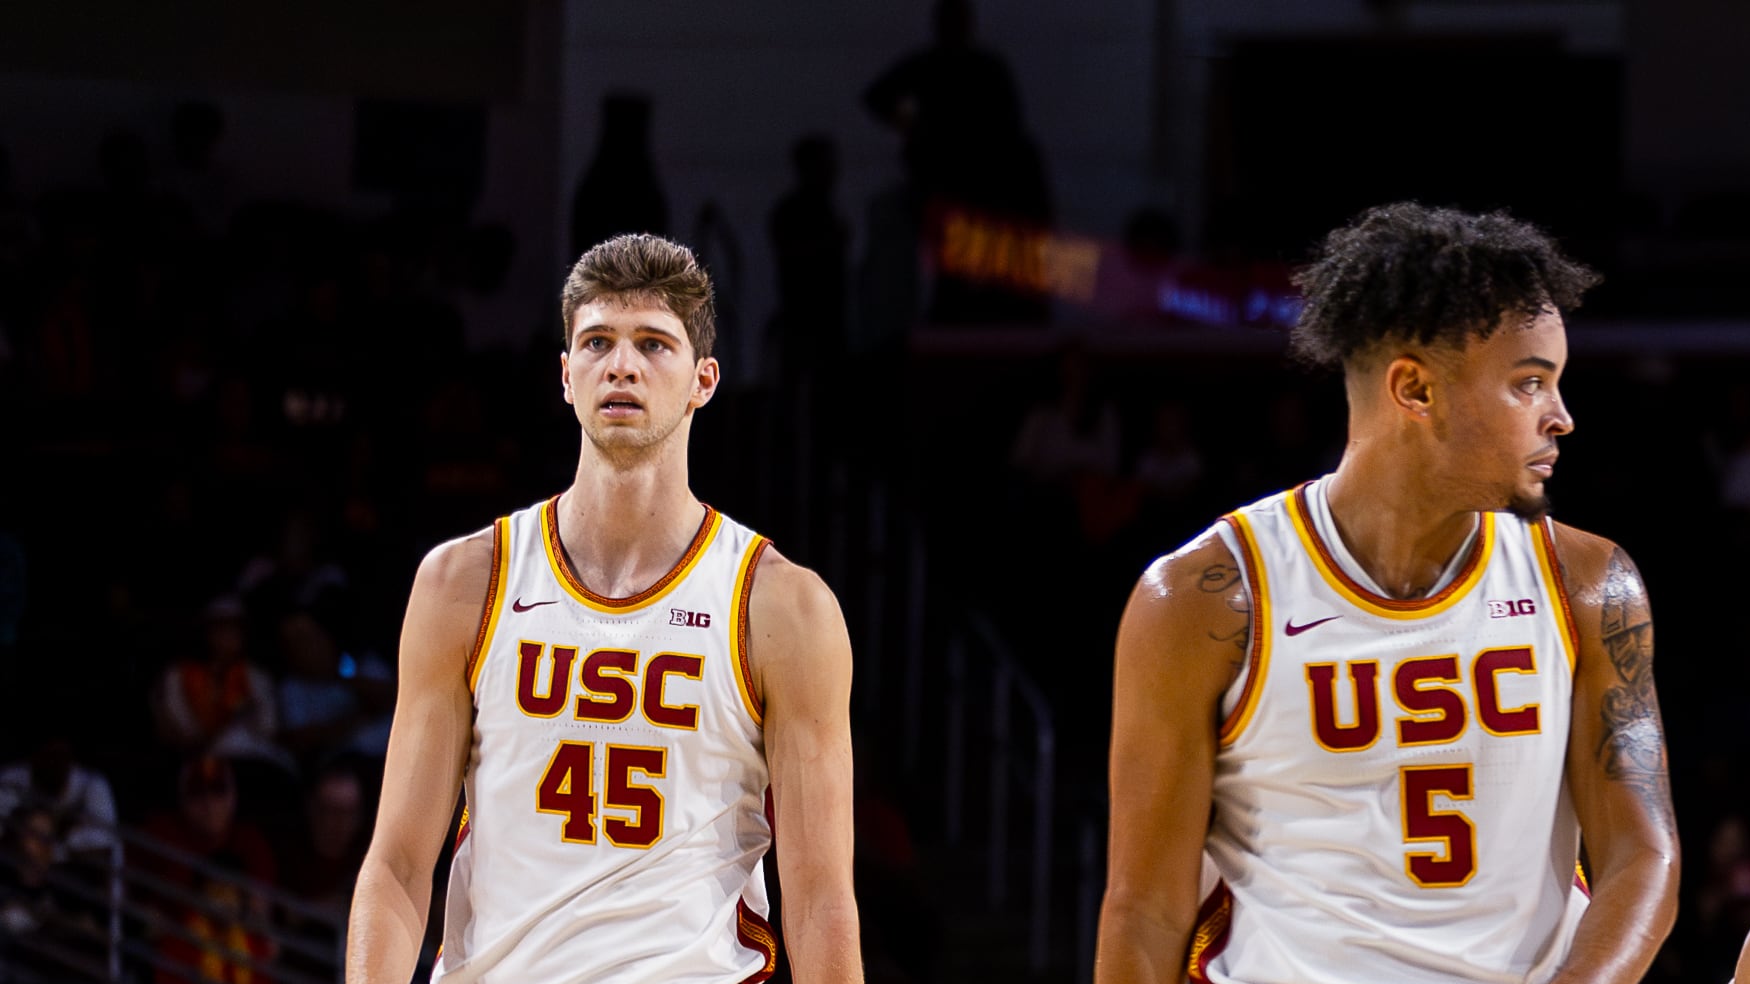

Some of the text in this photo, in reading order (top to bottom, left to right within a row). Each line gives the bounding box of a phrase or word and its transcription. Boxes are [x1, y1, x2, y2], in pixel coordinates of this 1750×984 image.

[515, 639, 705, 731] USC
[1304, 645, 1541, 753] USC
[535, 739, 668, 849] 45
[1398, 762, 1477, 889] 5
